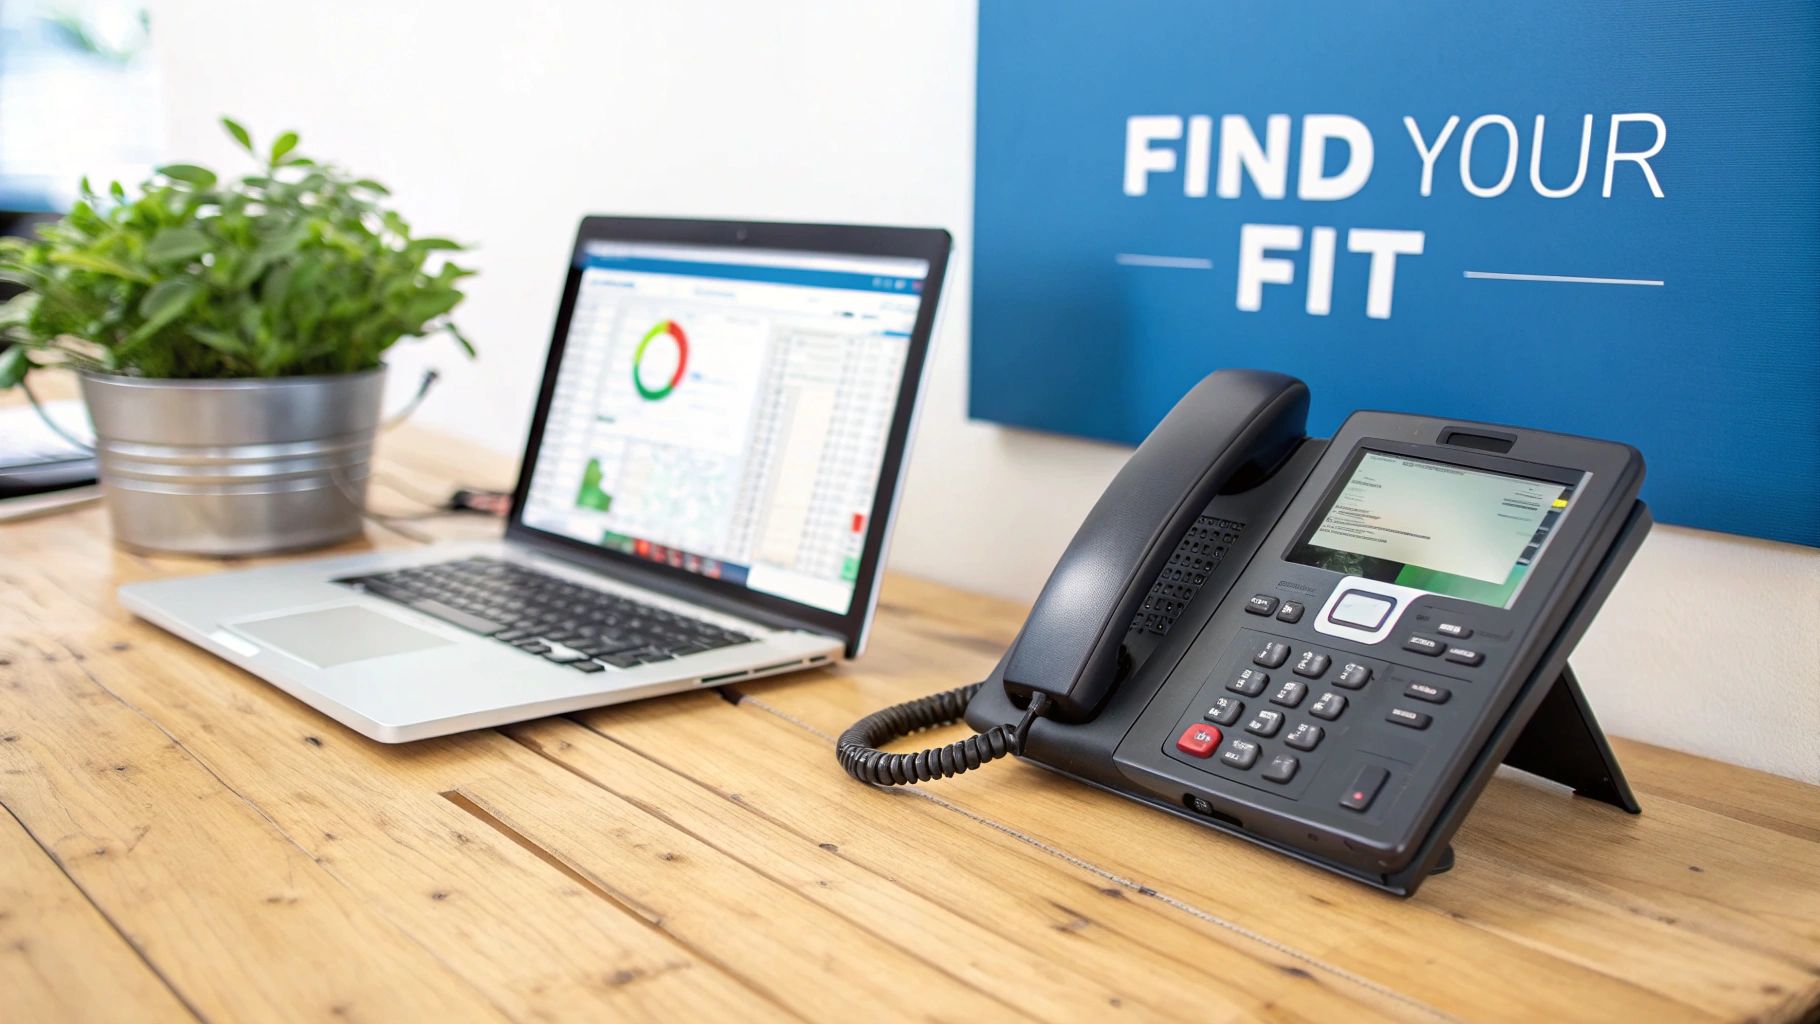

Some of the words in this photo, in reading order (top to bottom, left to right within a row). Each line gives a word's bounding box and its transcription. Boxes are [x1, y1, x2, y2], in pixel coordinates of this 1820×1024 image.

[1123, 113, 1374, 201] FIND
[1403, 112, 1667, 199] YOUR
[1236, 223, 1425, 320] FIT
